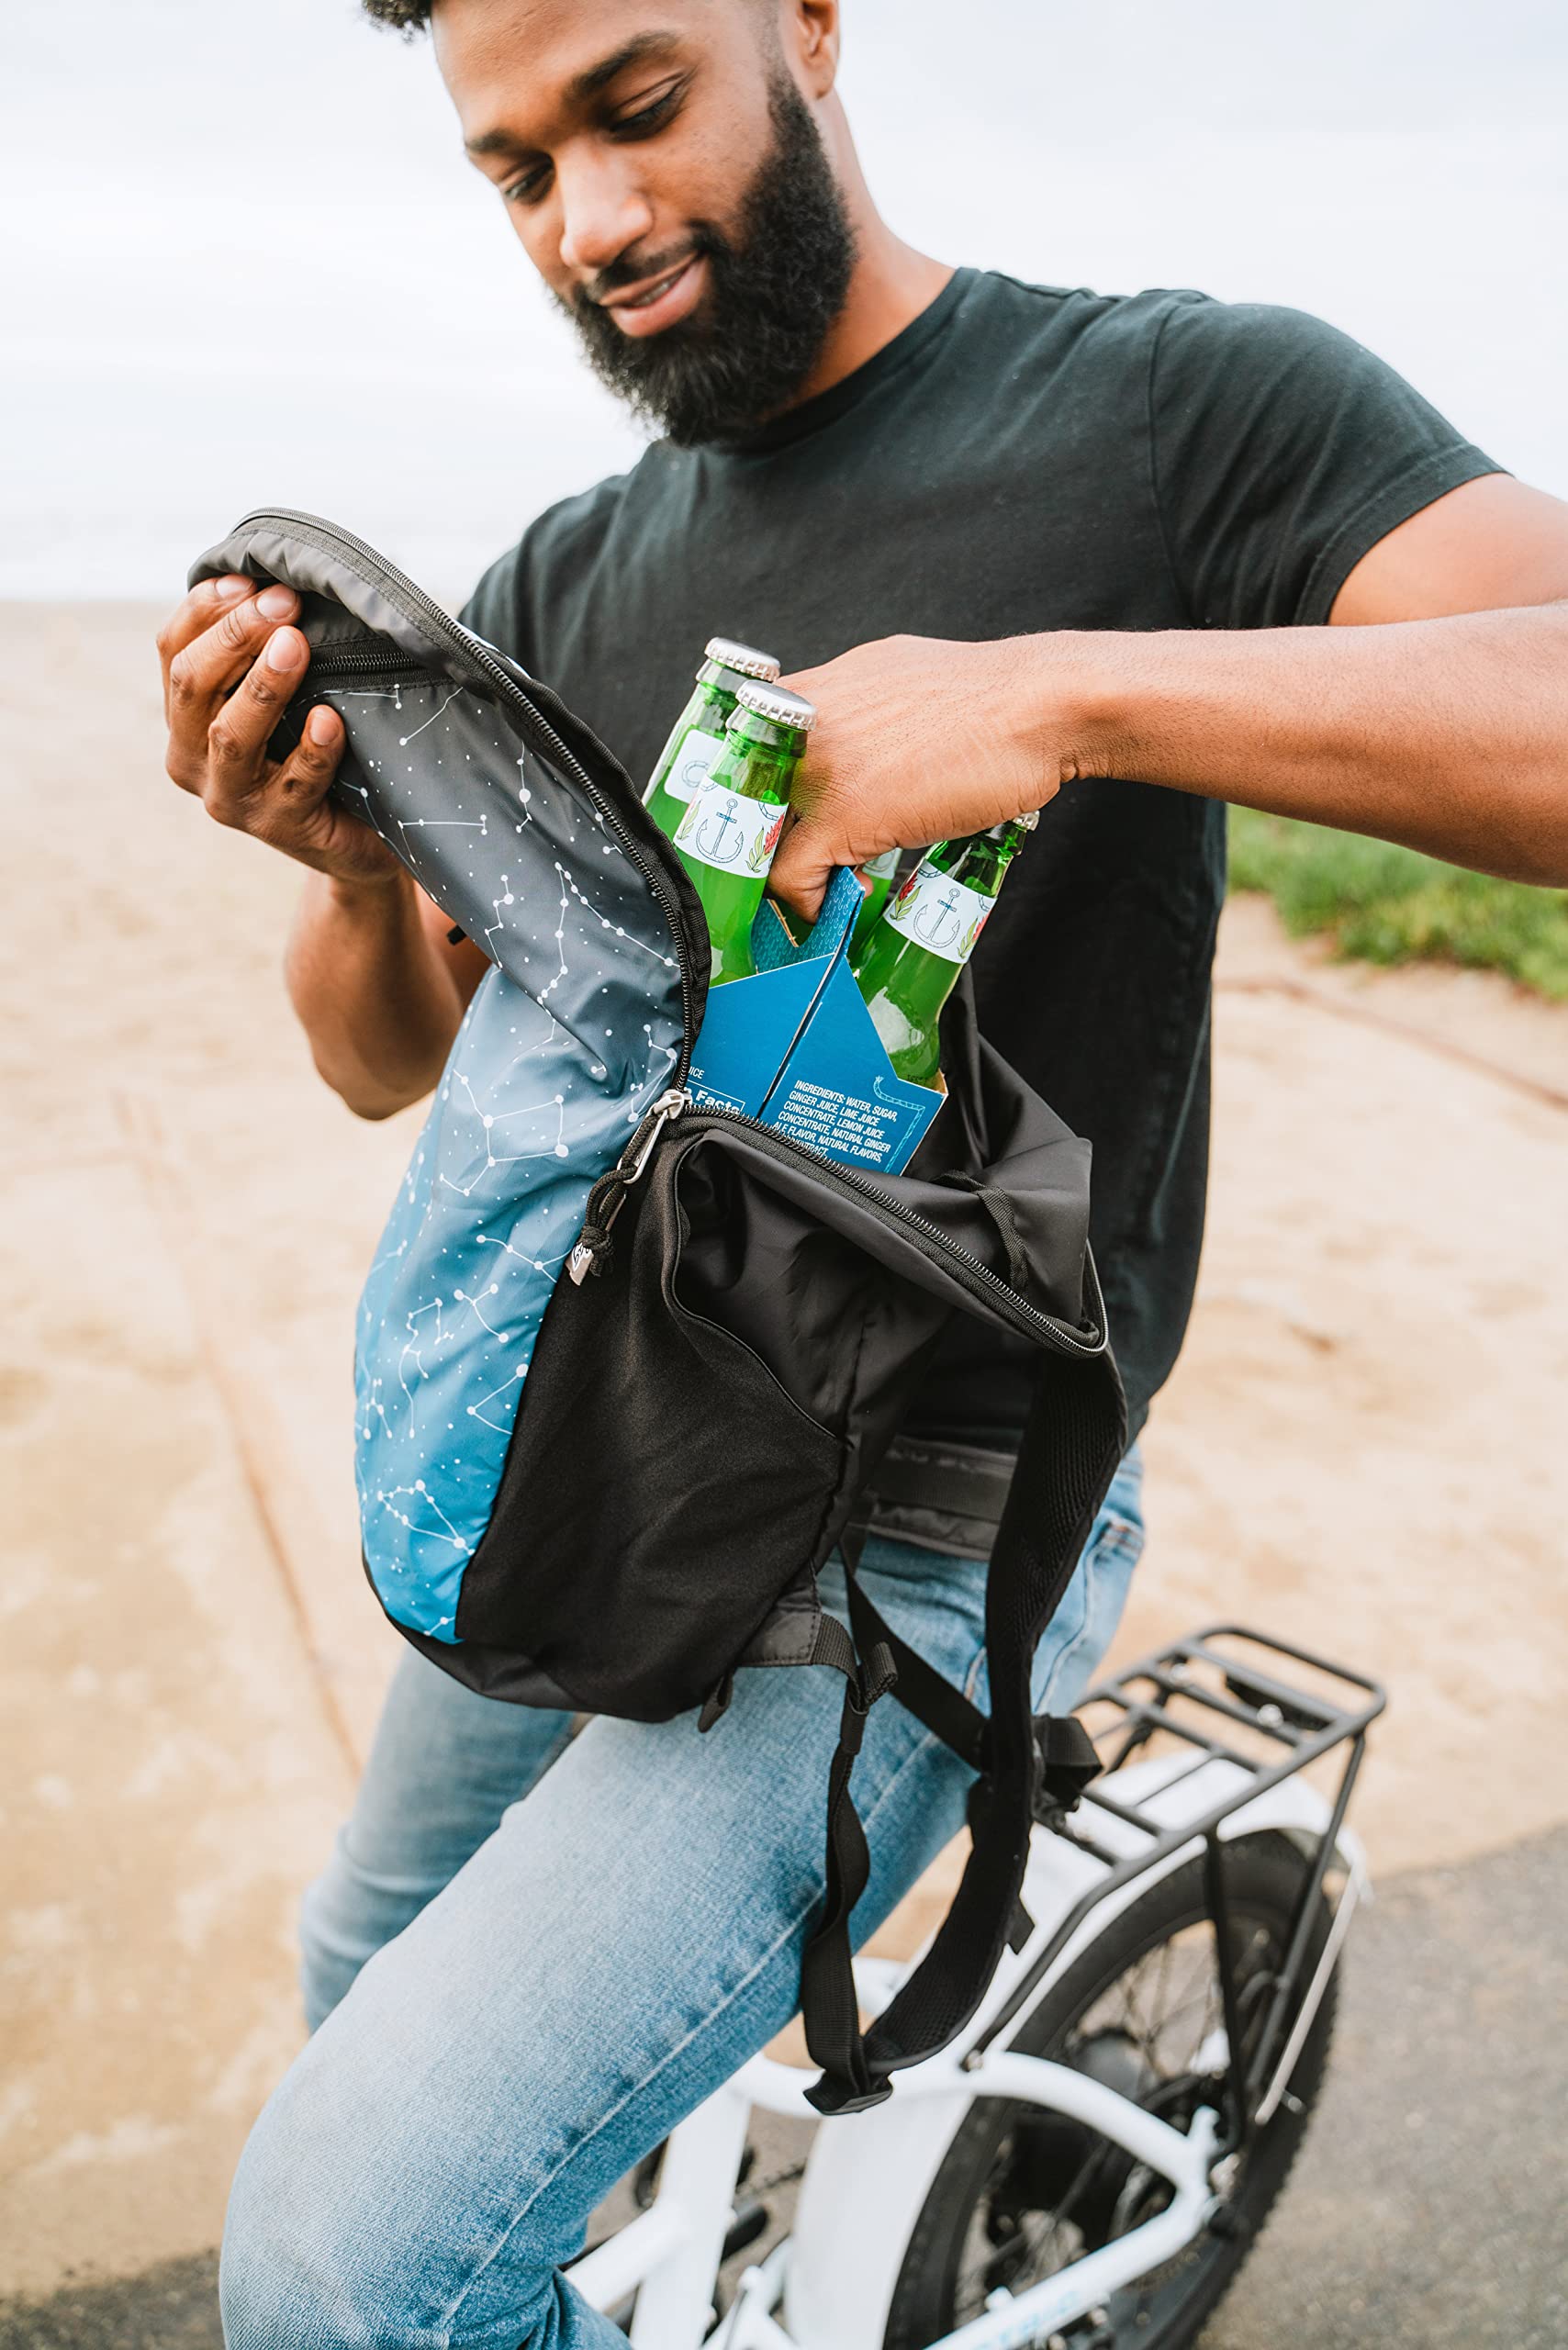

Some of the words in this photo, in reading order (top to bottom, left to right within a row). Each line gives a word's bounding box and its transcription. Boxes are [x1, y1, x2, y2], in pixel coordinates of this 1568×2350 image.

[783, 1101, 836, 1125] CONCENTRATE,
[836, 1117, 864, 1134] LEMON
[863, 1126, 885, 1139] JUICE
[789, 1091, 817, 1106] GINGER
[816, 1100, 839, 1115] JUICE,
[839, 1107, 859, 1120] LIME
[858, 1113, 880, 1126] JUICE
[794, 1080, 846, 1103] INGREDIENTS:
[846, 1096, 871, 1113] WATER,
[872, 1105, 898, 1123] SUGAR,
[778, 1111, 832, 1136] CONCENTRATE,
[831, 1127, 863, 1146] NATURAL
[864, 1138, 891, 1153] GINGER
[787, 1125, 817, 1143] FLAVOR,
[817, 1135, 849, 1152] NATURAL
[849, 1145, 882, 1163] FLAVORS,
